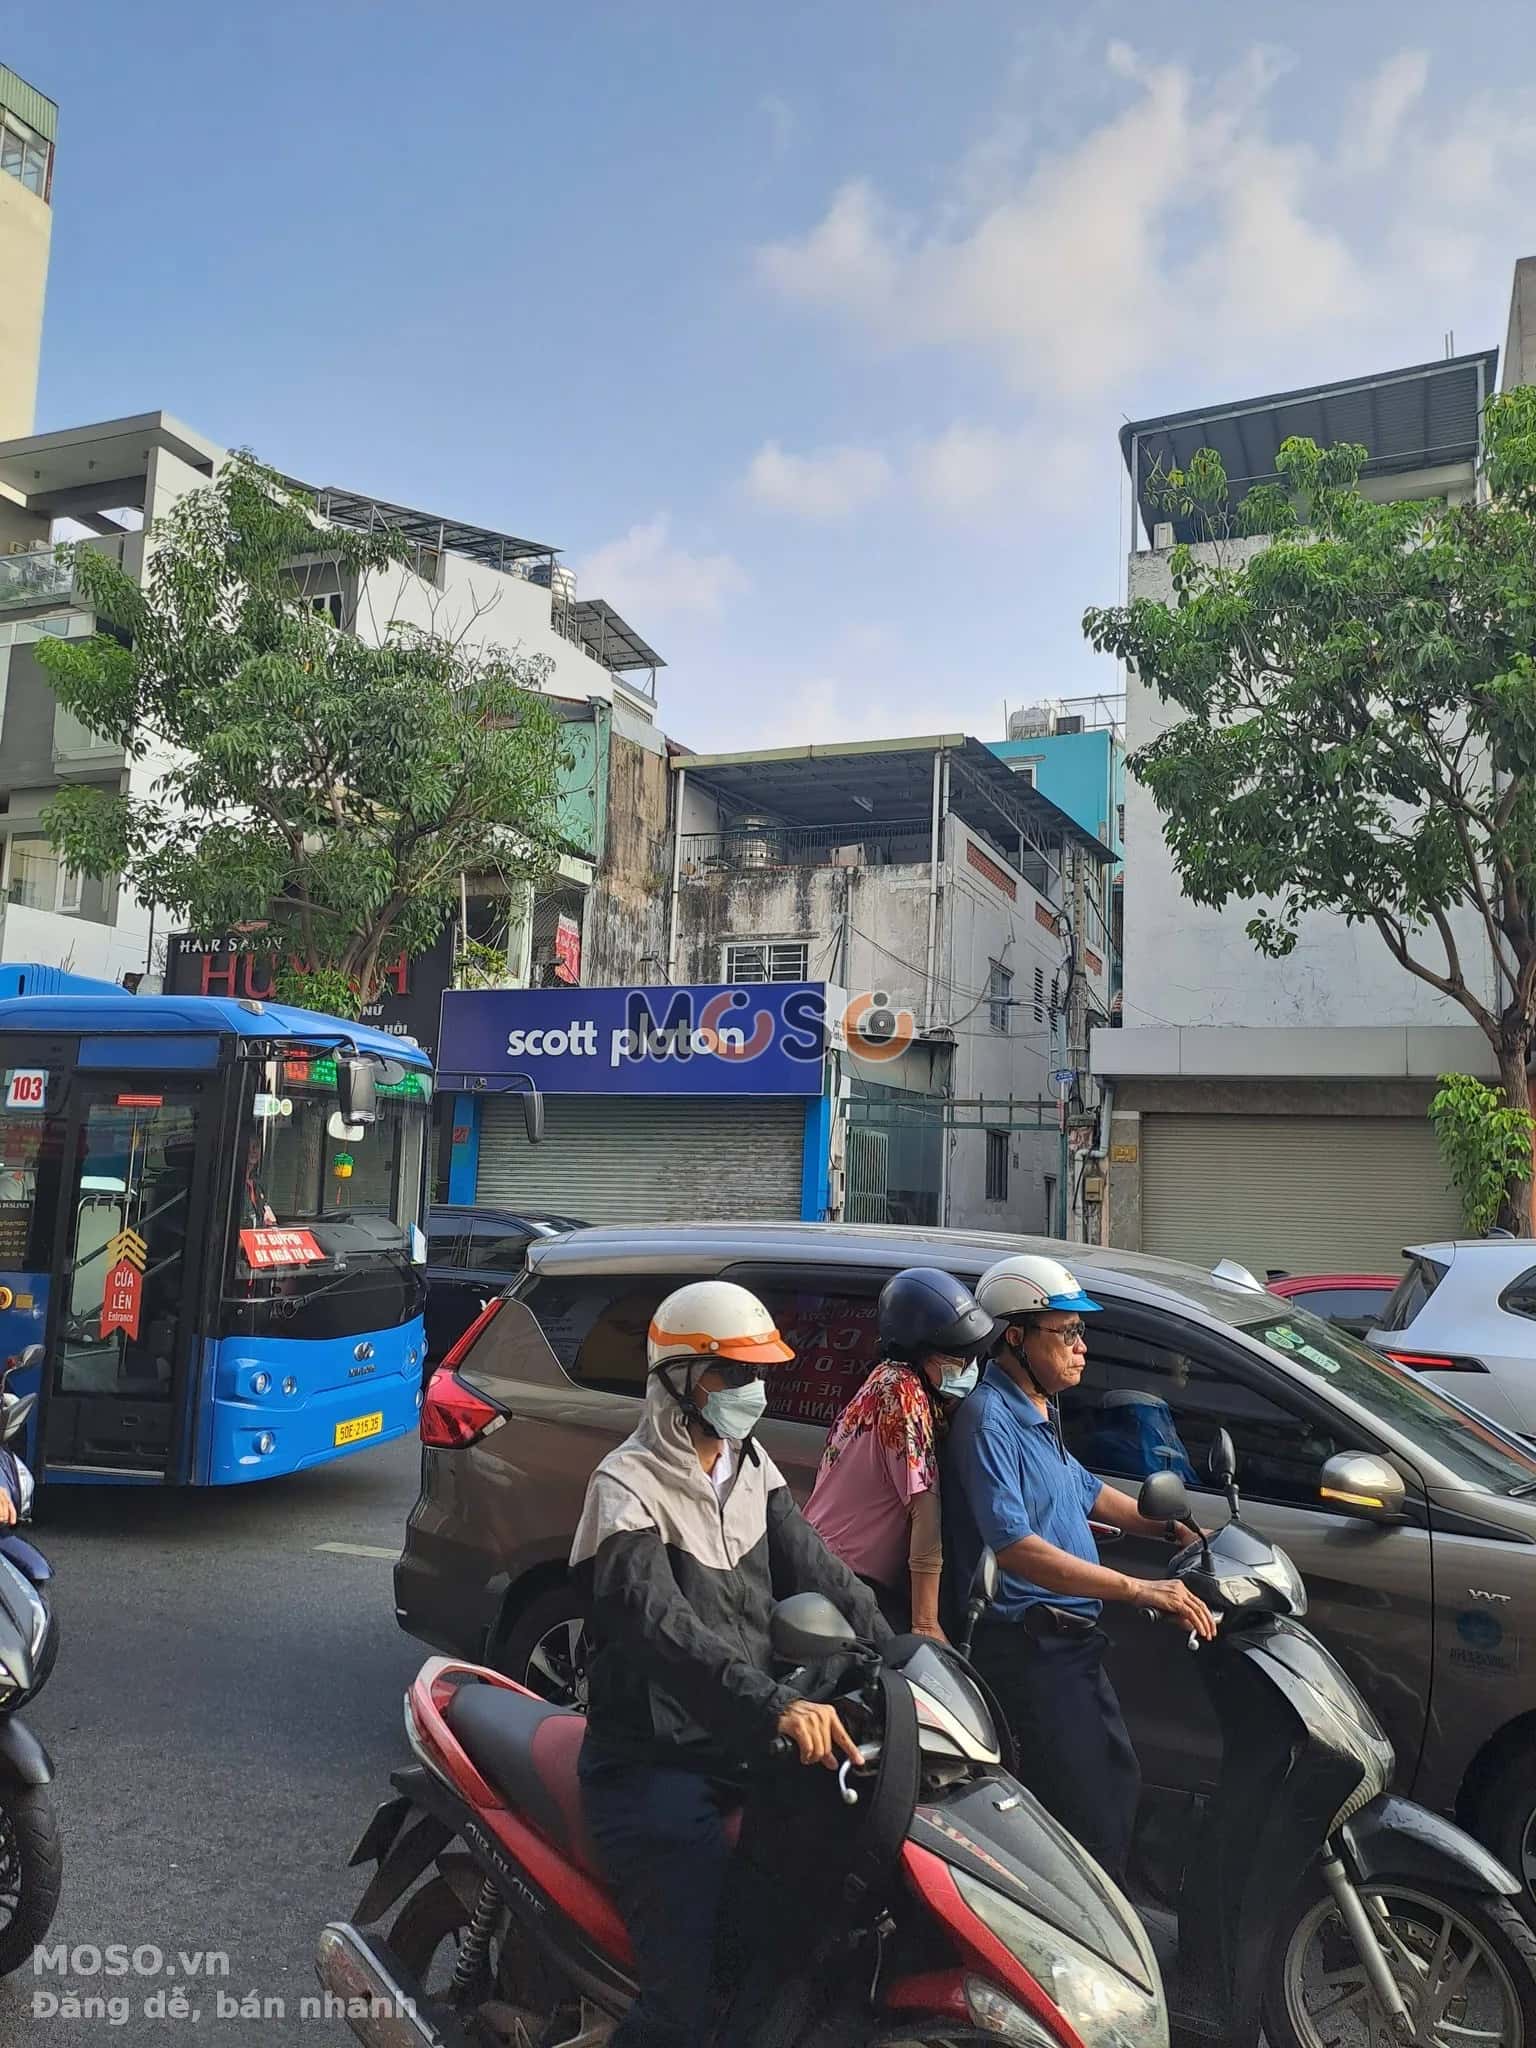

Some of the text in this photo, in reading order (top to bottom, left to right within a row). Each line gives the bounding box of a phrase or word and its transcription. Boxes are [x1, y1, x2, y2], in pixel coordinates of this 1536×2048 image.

[180, 939, 221, 953] HAIR
[507, 1012, 745, 1067] scott platon
[13, 1076, 42, 1100] 103
[114, 1266, 134, 1288] CỬA
[112, 1290, 133, 1310] LÊN
[108, 1311, 134, 1323] Entrance
